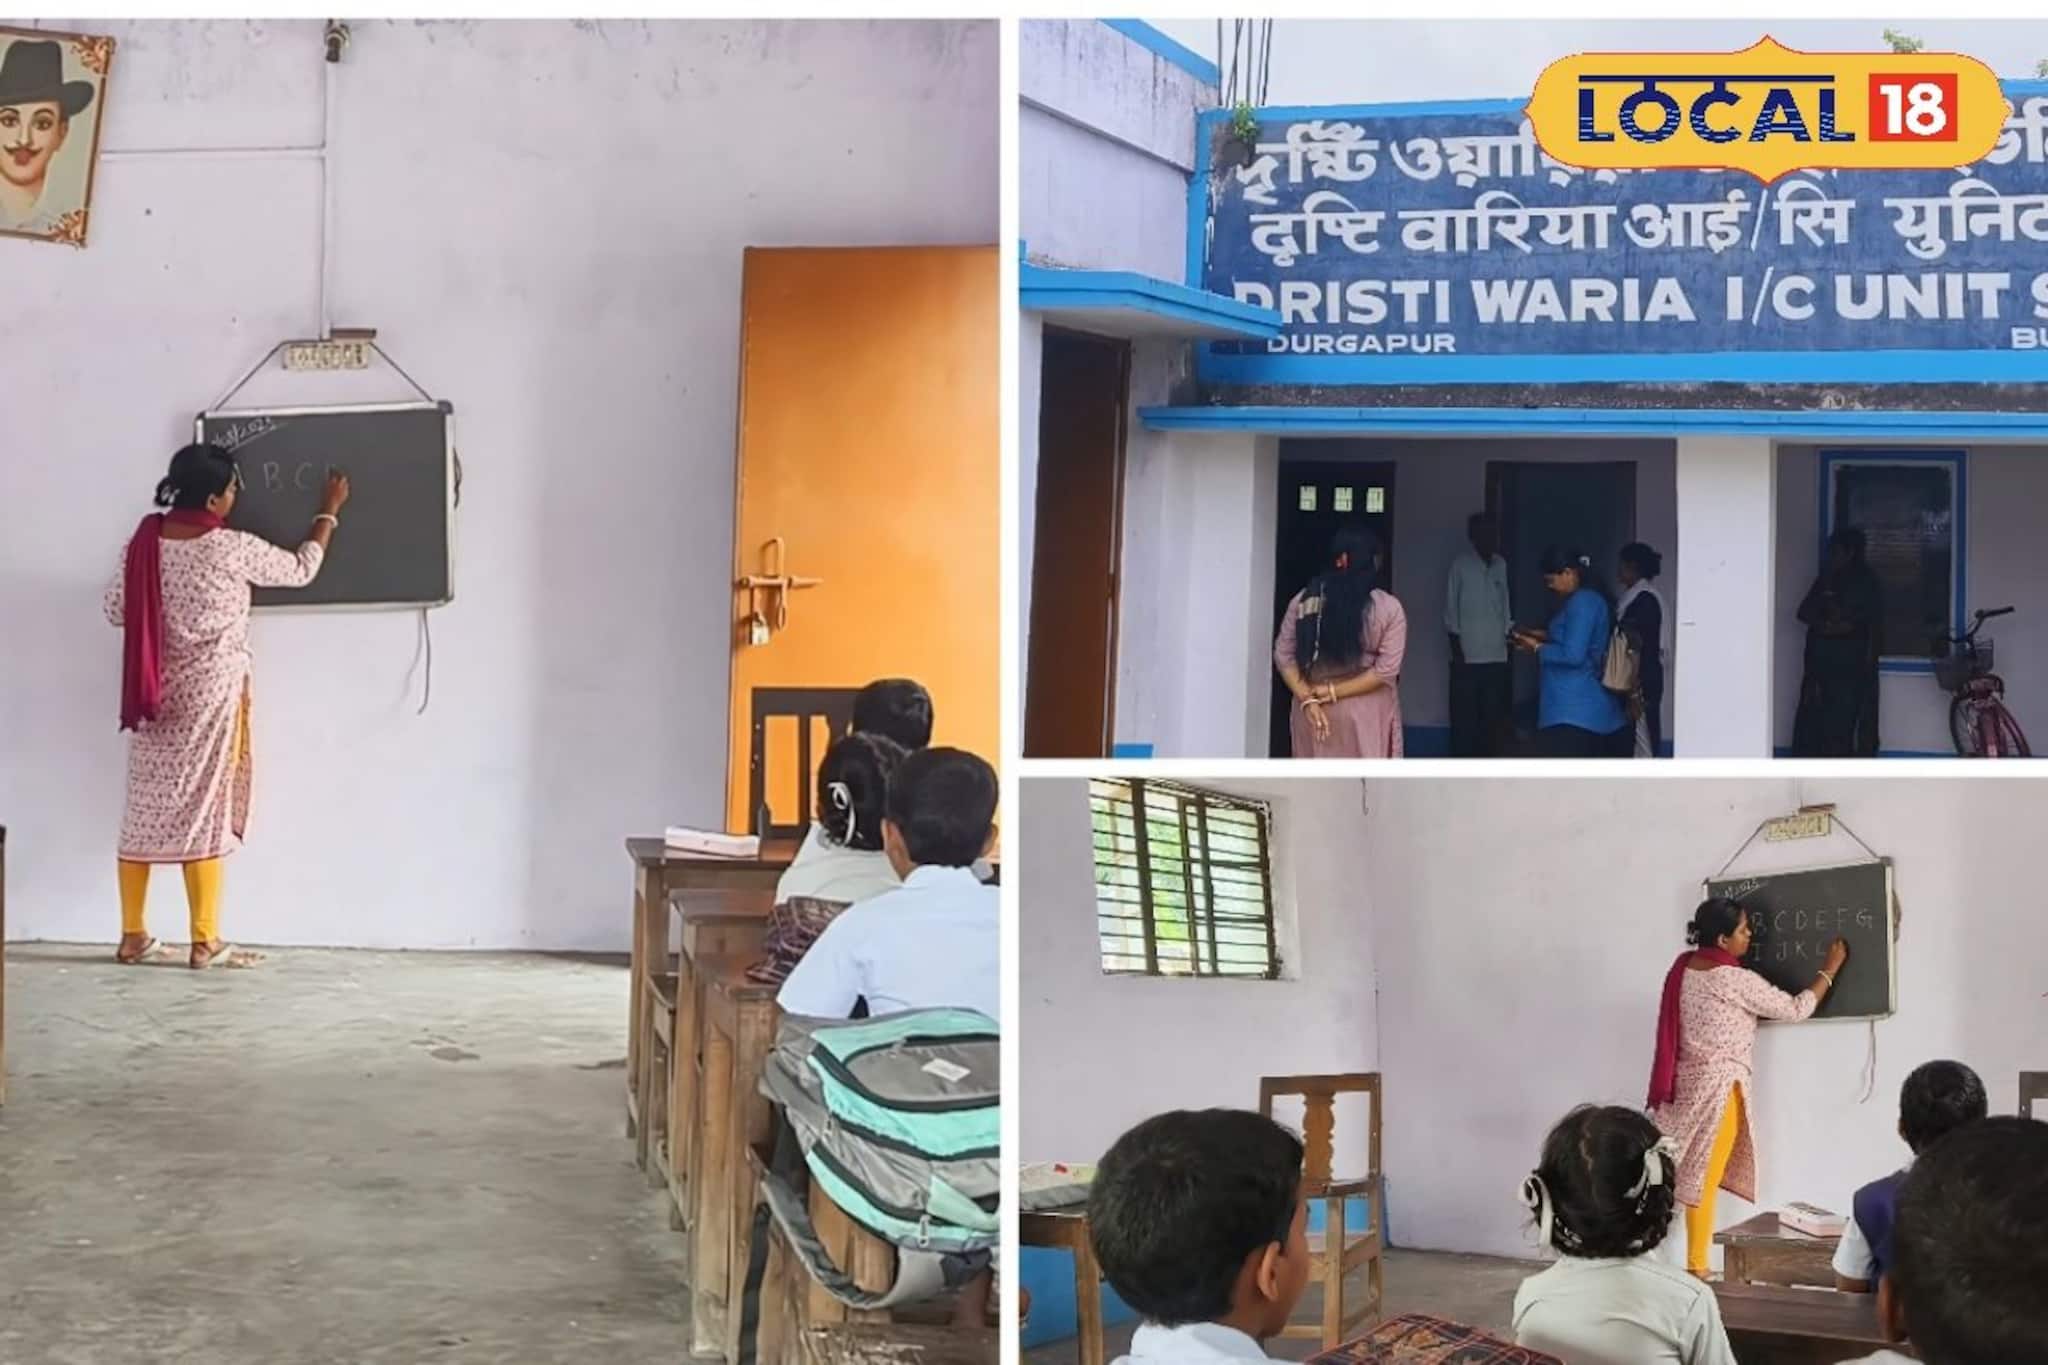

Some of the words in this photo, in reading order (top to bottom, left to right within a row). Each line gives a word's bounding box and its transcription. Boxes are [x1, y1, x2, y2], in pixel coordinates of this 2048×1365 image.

[1249, 190, 1386, 267] दृष्टि
[1397, 190, 1617, 254] वारिया
[1470, 277, 1696, 323] WARIA
[1726, 266, 1816, 326] I/C
[1835, 272, 2010, 320] UNIT
[1267, 333, 1456, 353] DURGAPUR
[263, 461, 283, 493] B
[295, 461, 313, 490] C
[1774, 909, 1787, 932] C
[1795, 909, 1809, 931] D
[1815, 908, 1828, 931] E
[1856, 908, 1873, 929] G
